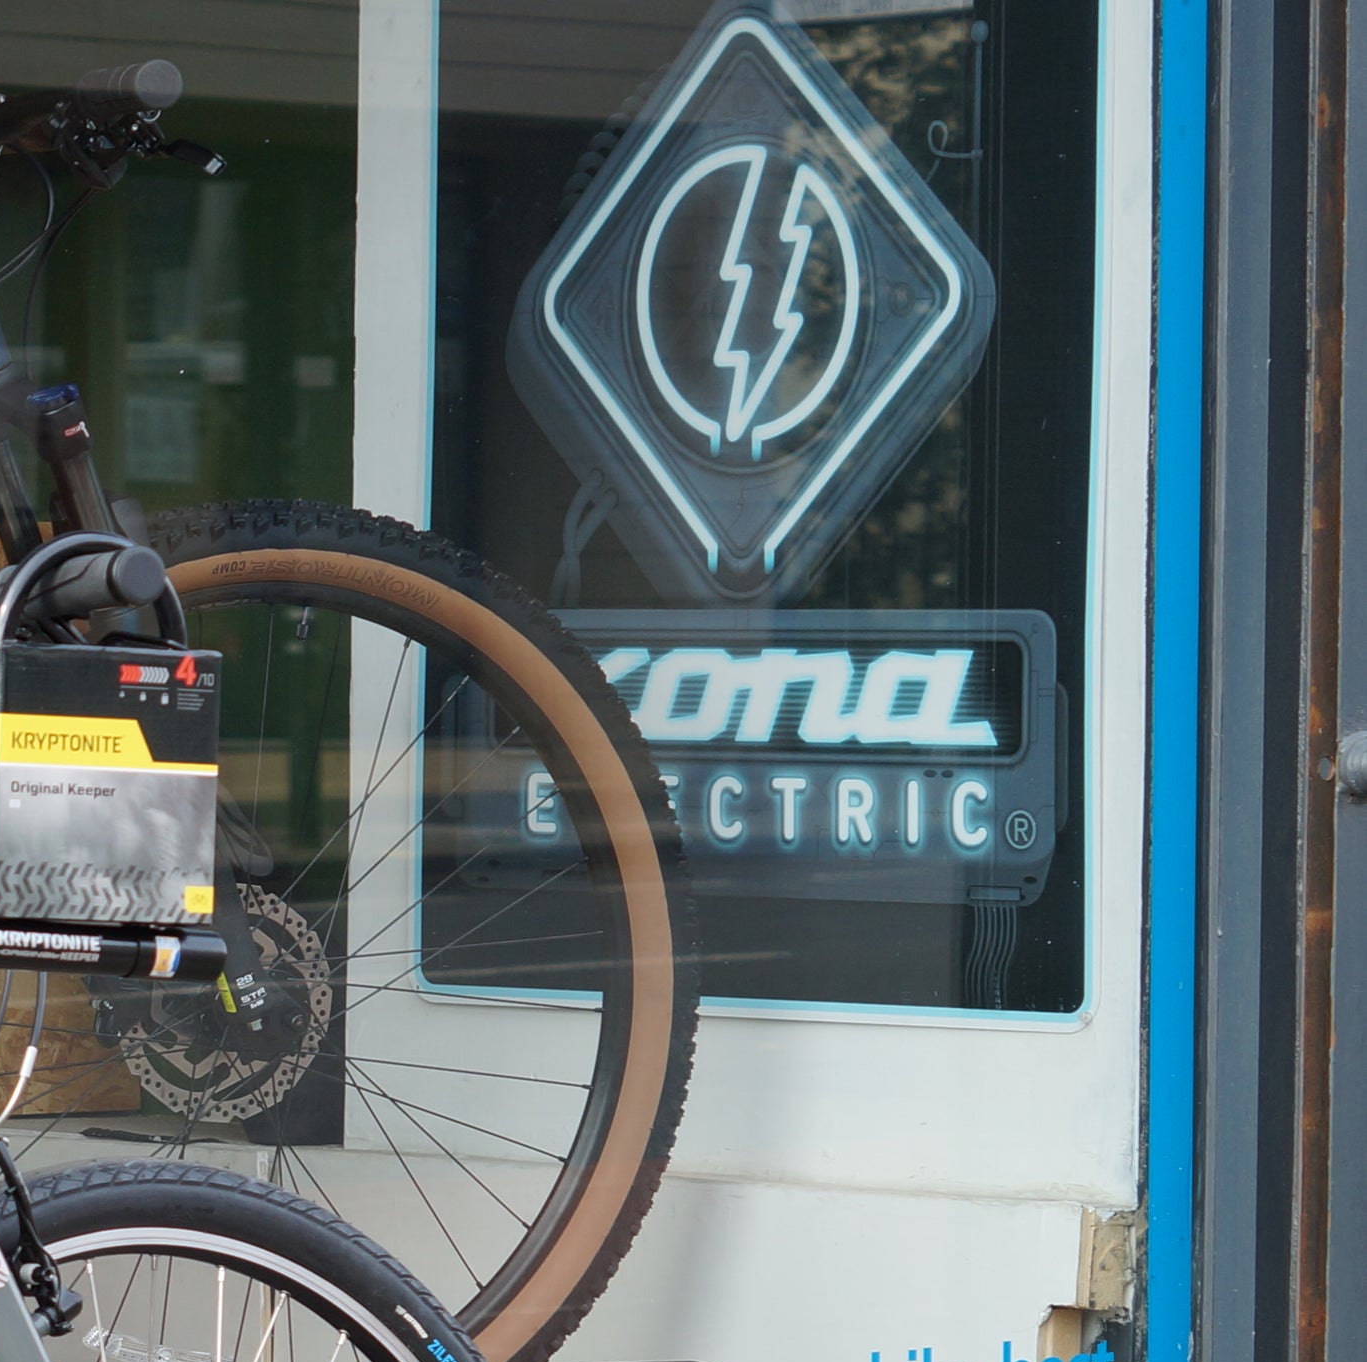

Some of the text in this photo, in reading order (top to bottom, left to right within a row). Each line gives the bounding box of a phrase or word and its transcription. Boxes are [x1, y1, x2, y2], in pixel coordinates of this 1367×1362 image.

[212, 560, 246, 575] COMP
[598, 648, 999, 747] ona
[11, 731, 122, 753] KRYPTONITE
[10, 780, 115, 798] Original Keeper
[527, 772, 988, 847] ECTRIC
